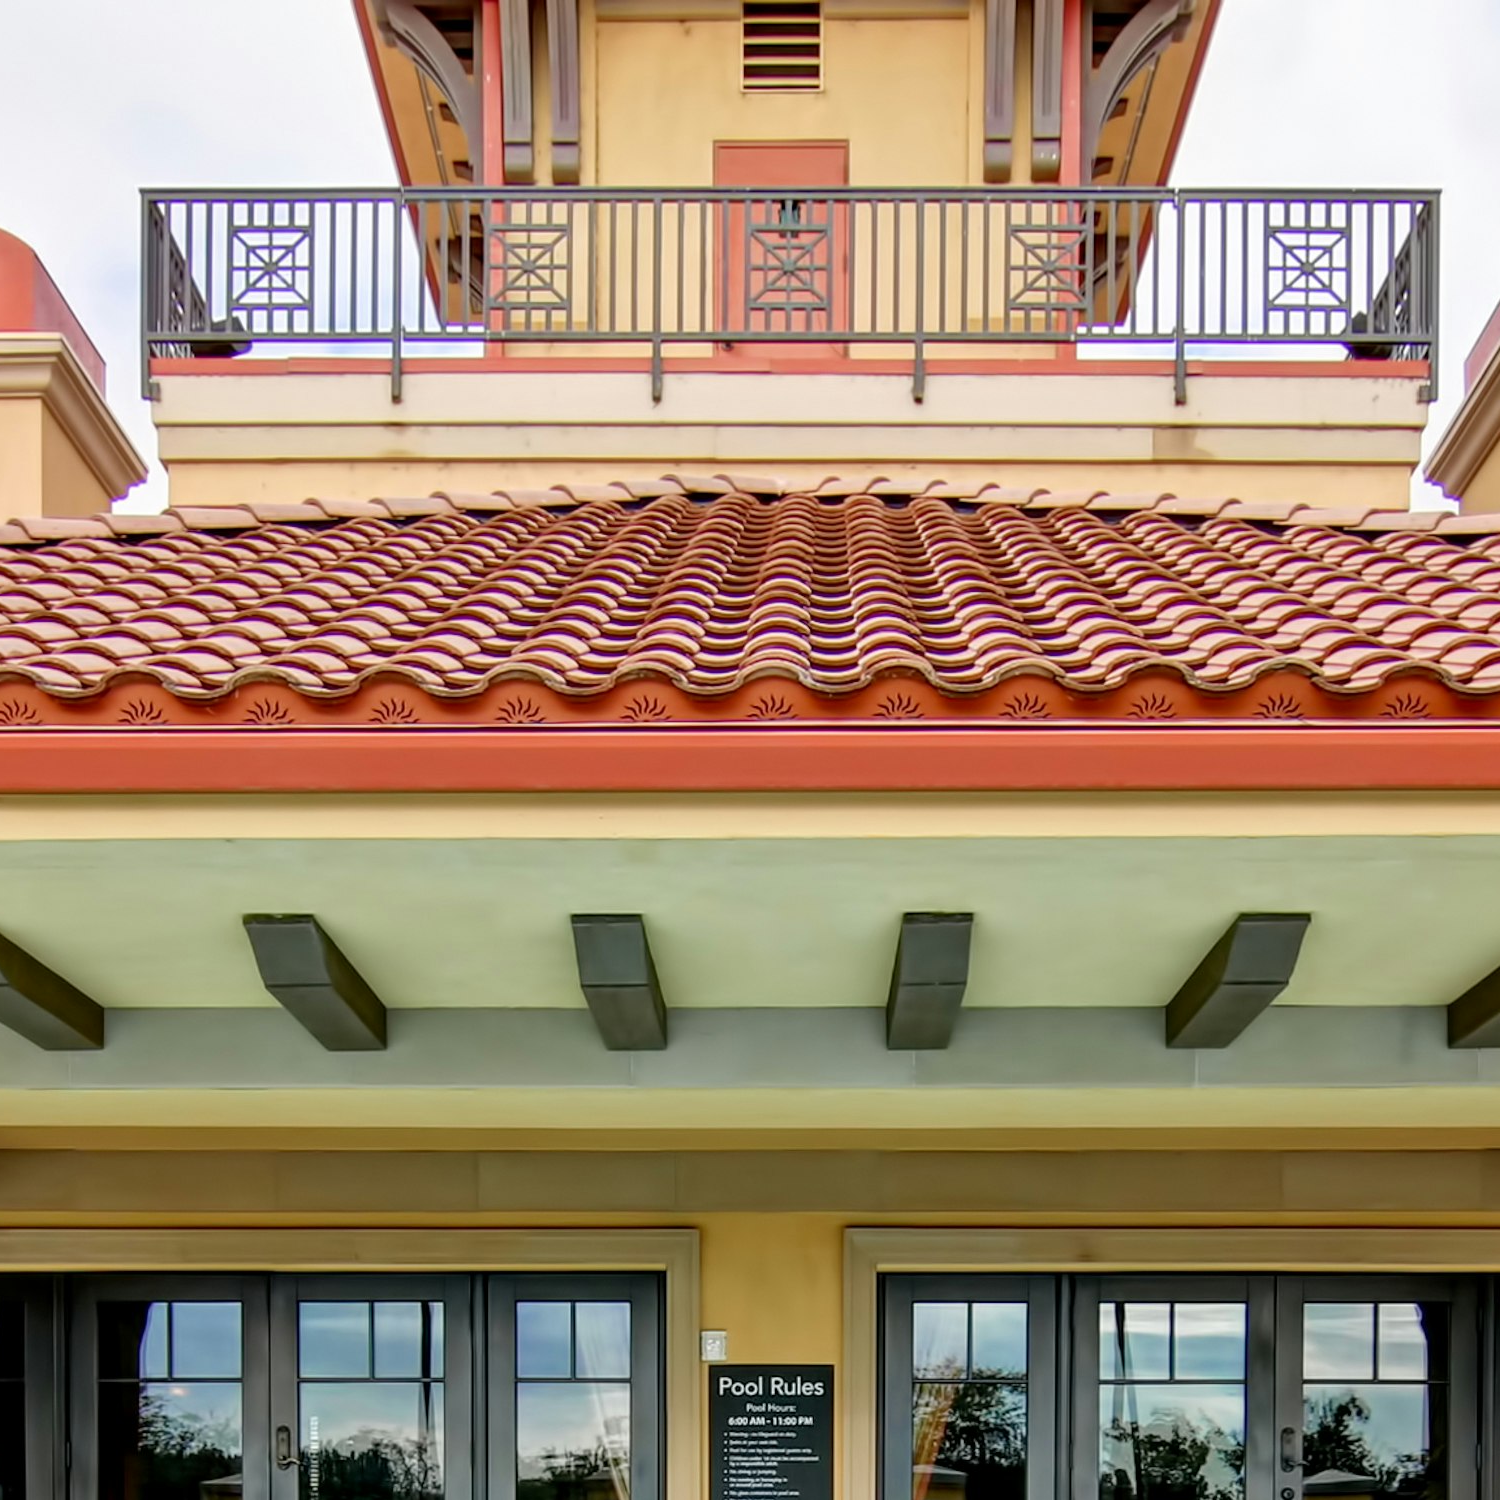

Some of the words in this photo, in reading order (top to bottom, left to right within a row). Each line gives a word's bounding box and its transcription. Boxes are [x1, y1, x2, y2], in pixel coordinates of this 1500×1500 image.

[719, 1376, 763, 1396] Pool
[770, 1376, 824, 1396] Rules
[746, 1403, 766, 1413] Pool
[749, 1416, 765, 1426] AM
[798, 1416, 814, 1426] PM
